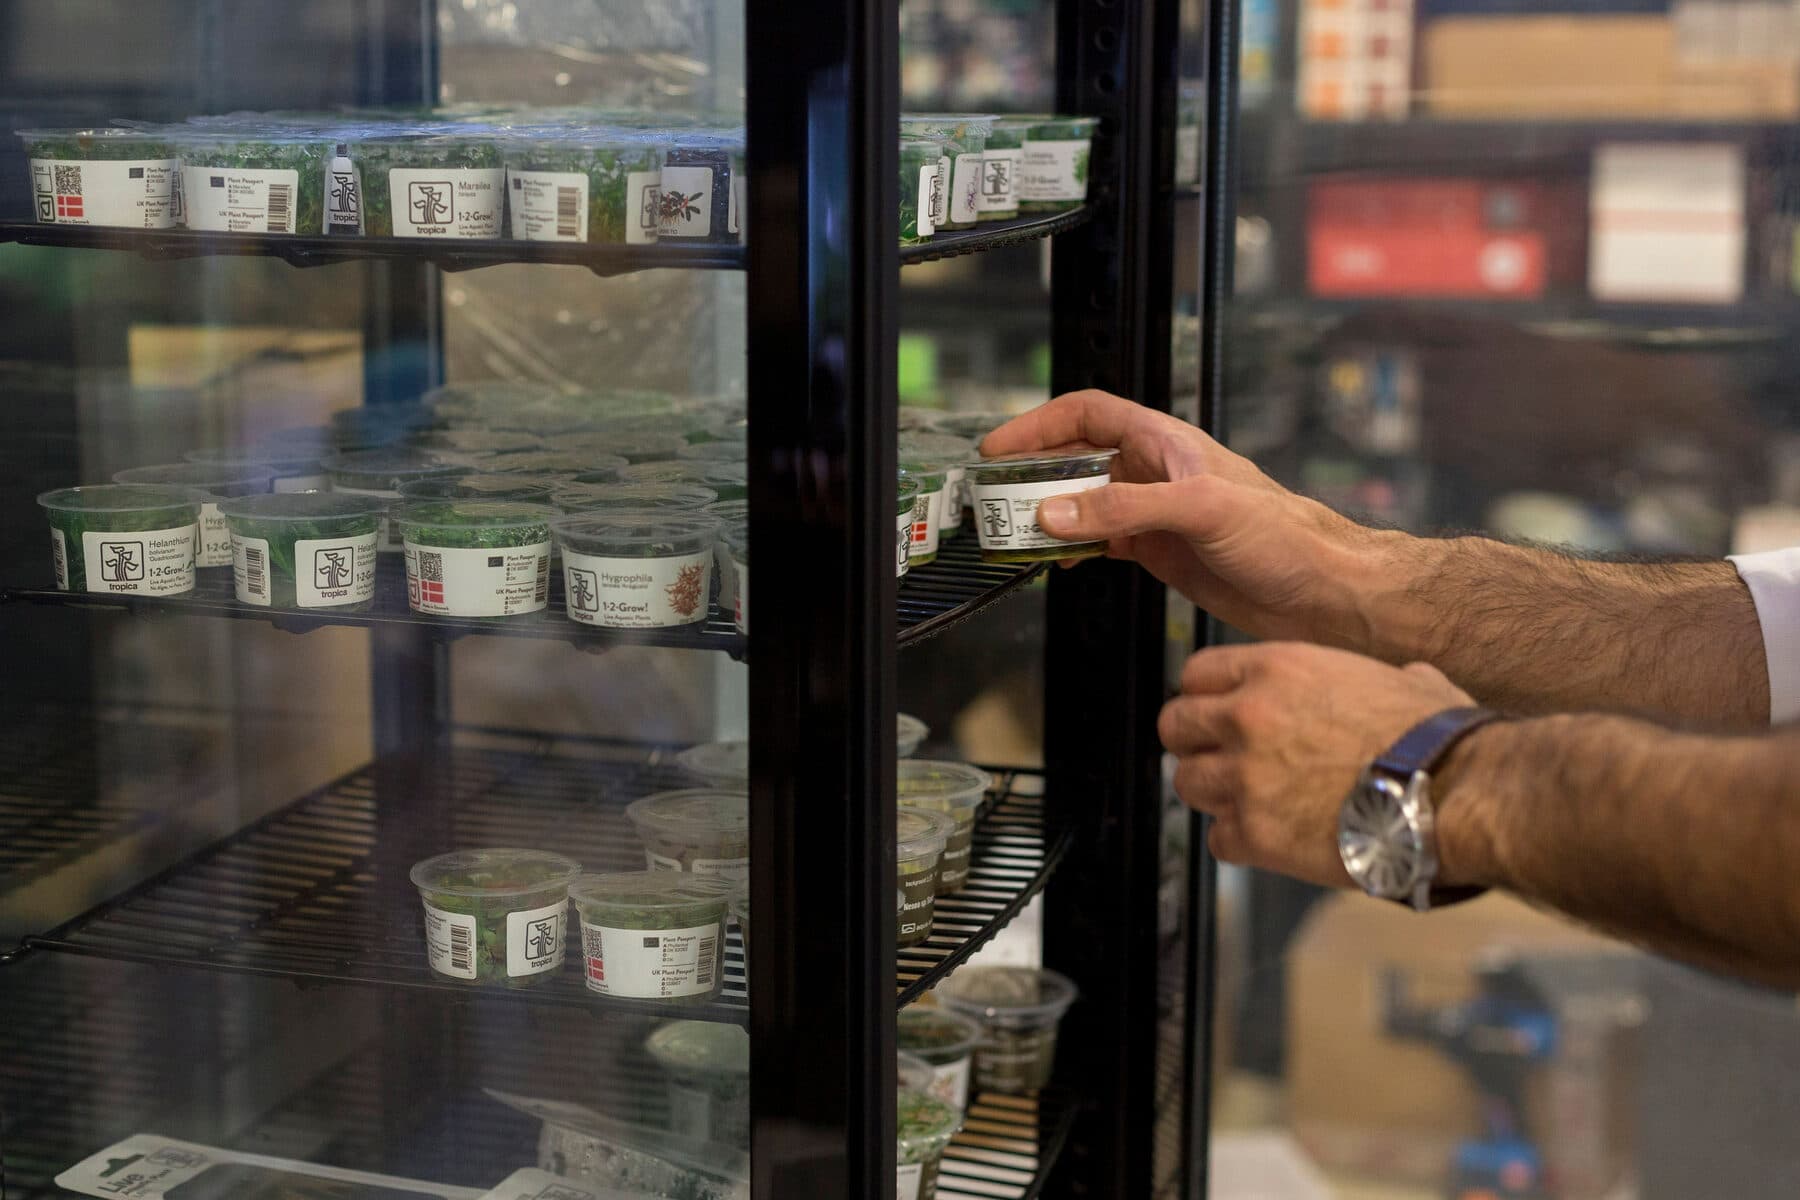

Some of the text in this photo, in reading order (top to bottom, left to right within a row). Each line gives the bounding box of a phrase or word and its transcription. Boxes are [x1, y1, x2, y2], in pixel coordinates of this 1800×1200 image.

[417, 226, 447, 236] tropica
[601, 573, 653, 584] Hygrophila
[109, 582, 138, 593] tropica
[321, 589, 348, 599] tropica
[603, 602, 648, 613] 1-2-Grow!
